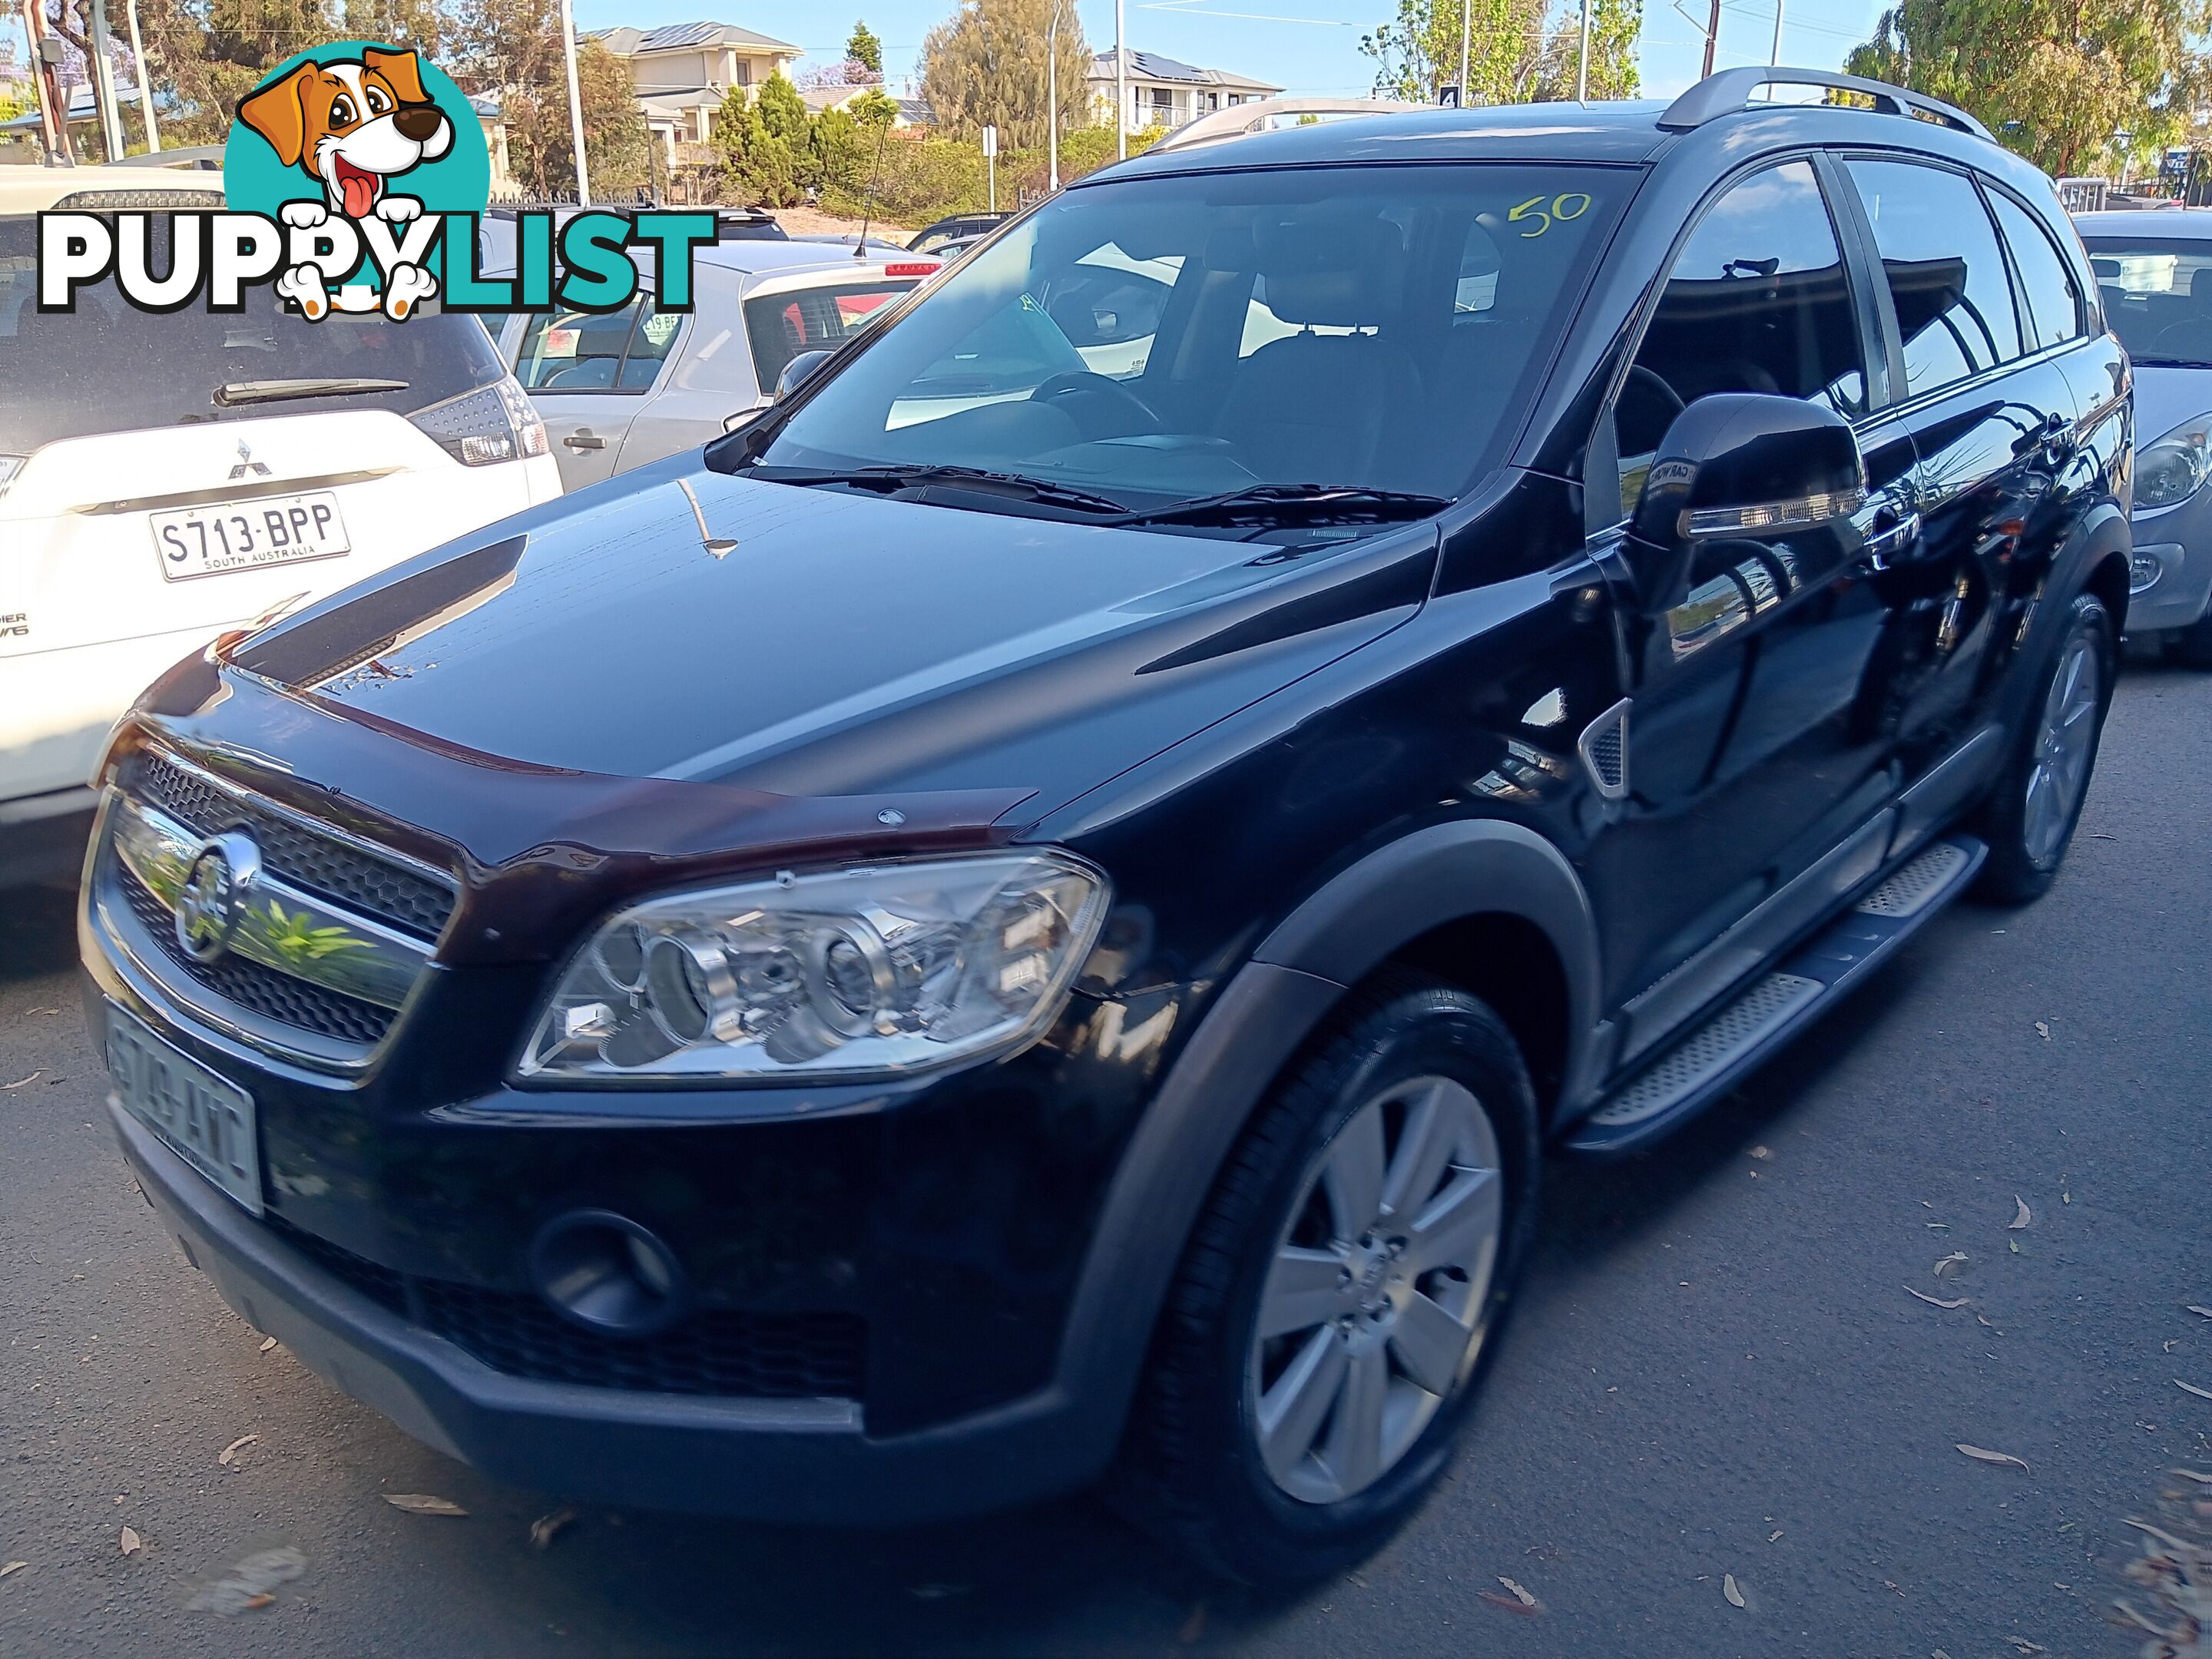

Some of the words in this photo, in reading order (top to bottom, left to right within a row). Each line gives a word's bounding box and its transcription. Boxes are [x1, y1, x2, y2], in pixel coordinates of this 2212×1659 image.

[1508, 193, 1591, 237] 50
[204, 556, 246, 570] SOUTH
[251, 545, 316, 562] AUSTRALIA
